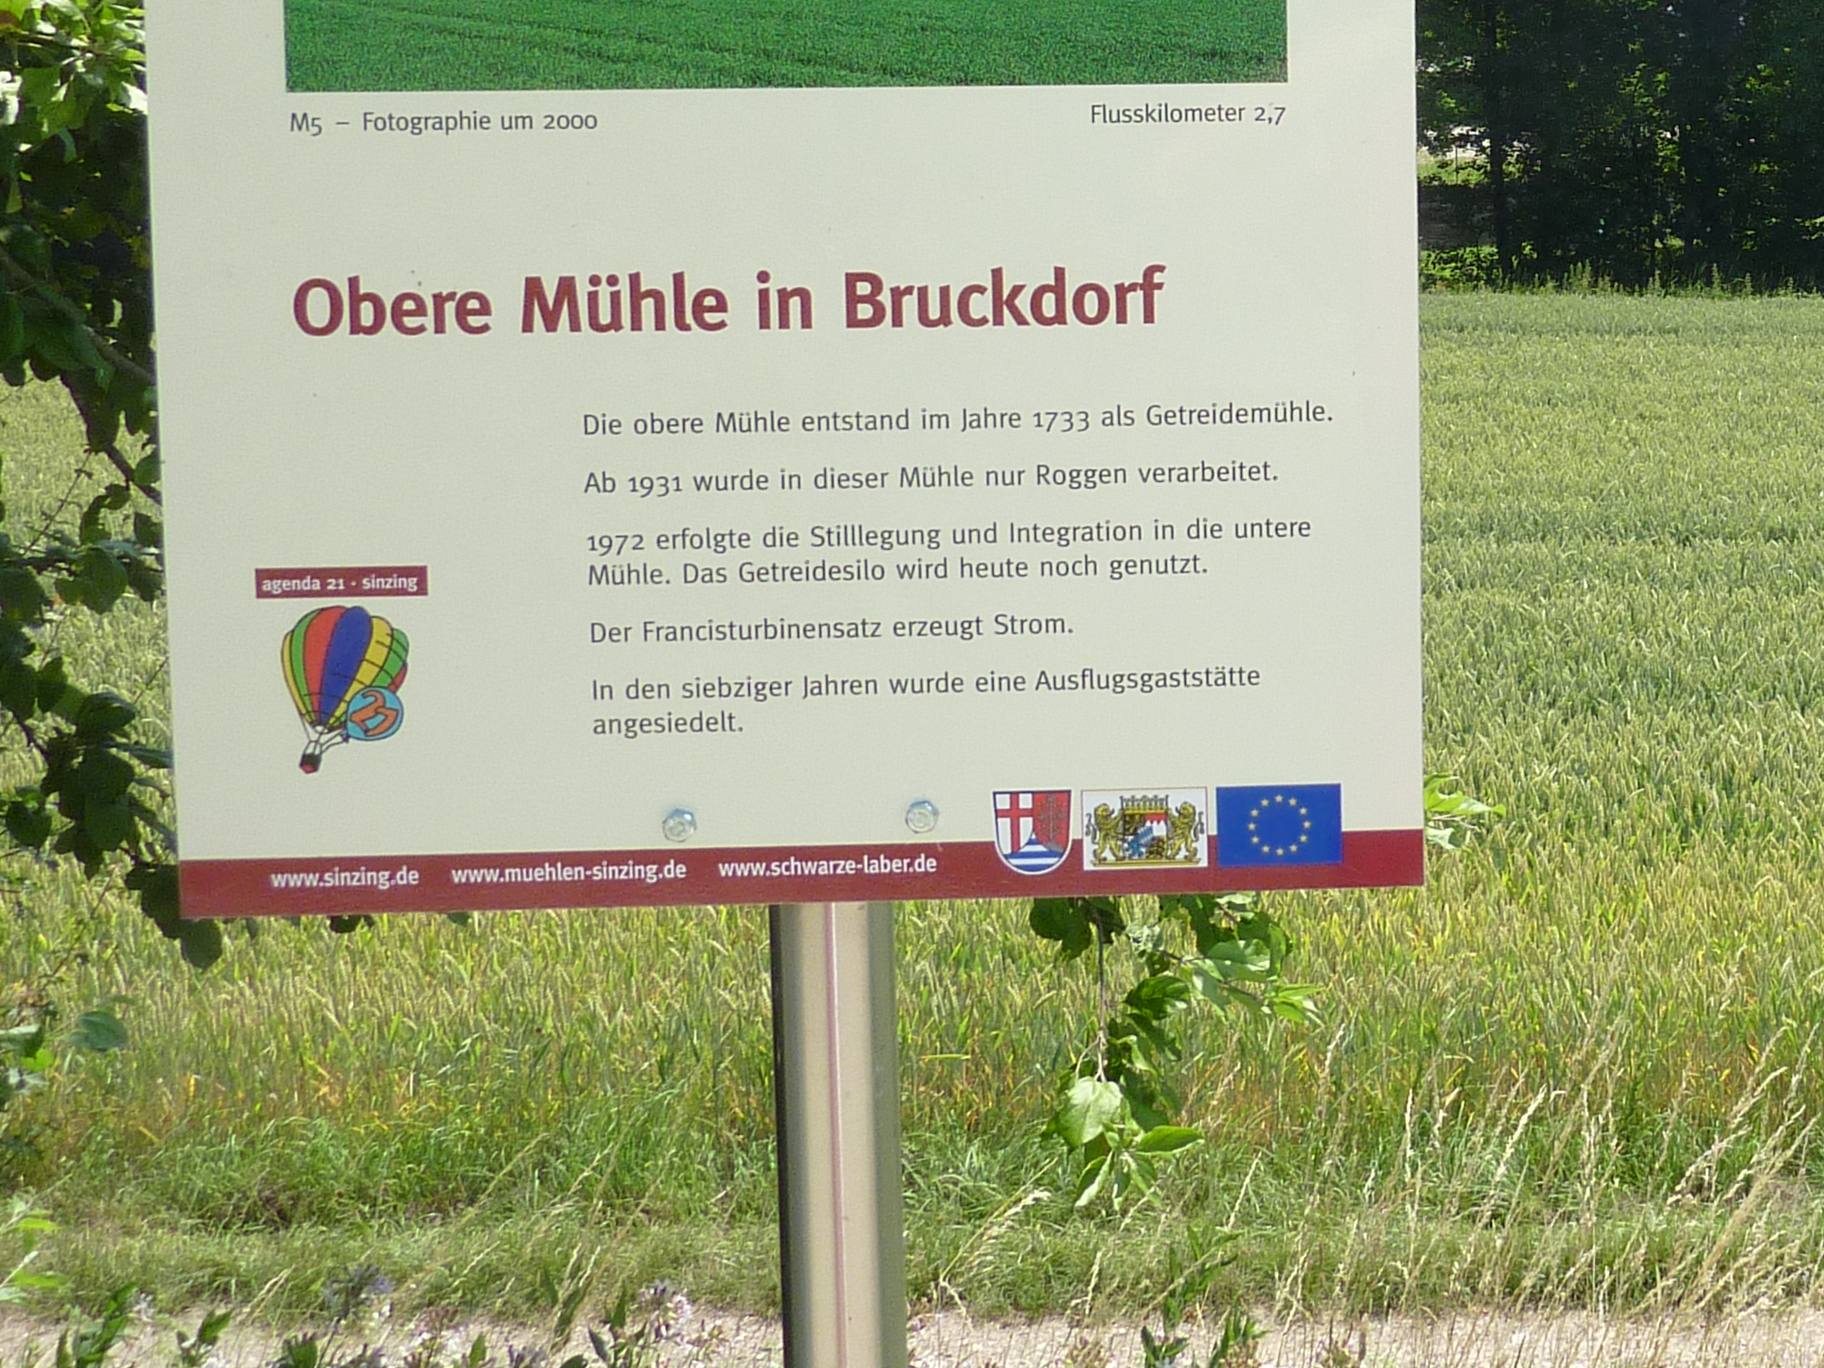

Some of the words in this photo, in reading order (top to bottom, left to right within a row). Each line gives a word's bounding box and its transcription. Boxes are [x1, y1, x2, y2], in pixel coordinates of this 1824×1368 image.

[290, 112, 323, 137] M5
[363, 109, 491, 136] Fotographie
[500, 115, 534, 131] um
[543, 114, 598, 130] 2000
[1091, 102, 1246, 124] Flusskilometer
[1254, 106, 1286, 126] 2,7
[293, 275, 492, 337] Obere
[521, 271, 729, 334] Mühle
[756, 270, 813, 330] in
[844, 264, 1167, 329] Bruckdorf
[583, 412, 622, 436] Die
[633, 412, 704, 435] obere
[715, 410, 790, 434] Mühle
[801, 407, 910, 432] entstand
[921, 408, 950, 430] im
[961, 406, 1022, 433] Jahre
[1032, 410, 1090, 433] 1733
[1101, 404, 1135, 427] als
[1146, 399, 1333, 426] Getreidemühle.
[583, 470, 617, 494] Ab
[628, 475, 683, 499] 1931
[692, 468, 769, 492] wurde
[780, 468, 802, 490] in
[813, 466, 889, 490] dieser
[899, 464, 974, 488] Mühle
[985, 469, 1026, 487] nur
[1036, 464, 1127, 490] Roggen
[1138, 460, 1278, 484] verarbeitet.
[587, 534, 645, 557] 1972
[656, 526, 751, 555] erfolgte
[762, 525, 799, 548] die
[810, 524, 941, 551] Stilllegung
[952, 521, 998, 545] und
[1010, 519, 1142, 548] Integration
[1153, 518, 1175, 541] in
[1186, 517, 1223, 540] die
[1234, 518, 1311, 539] untere
[261, 575, 321, 595] agenda
[326, 578, 345, 590] 21
[361, 573, 418, 593] sinzing
[588, 562, 671, 586] Mühle.
[683, 562, 728, 584] Das
[738, 558, 885, 583] Getreidesilo
[895, 556, 948, 580] wird
[960, 556, 1029, 579] heute
[1040, 553, 1098, 577] noch
[1109, 554, 1208, 581] genutzt.
[590, 622, 633, 644] Der
[643, 617, 882, 643] Francisturbinensatz
[892, 616, 984, 641] erzeugt
[994, 613, 1074, 635] Strom.
[592, 679, 614, 701] In
[625, 677, 670, 700] den
[681, 675, 793, 703] siebziger
[802, 673, 878, 700] Jahren
[888, 671, 964, 695] wurde
[975, 670, 1027, 693] eine
[1034, 666, 1261, 695] Ausflugsgaststätte
[592, 710, 743, 740] angesiedelt.
[270, 865, 420, 890] www.sinzing.de
[451, 858, 687, 884] www.muehlen-sinzing.de
[718, 852, 937, 877] www.schwarze-laber.de
